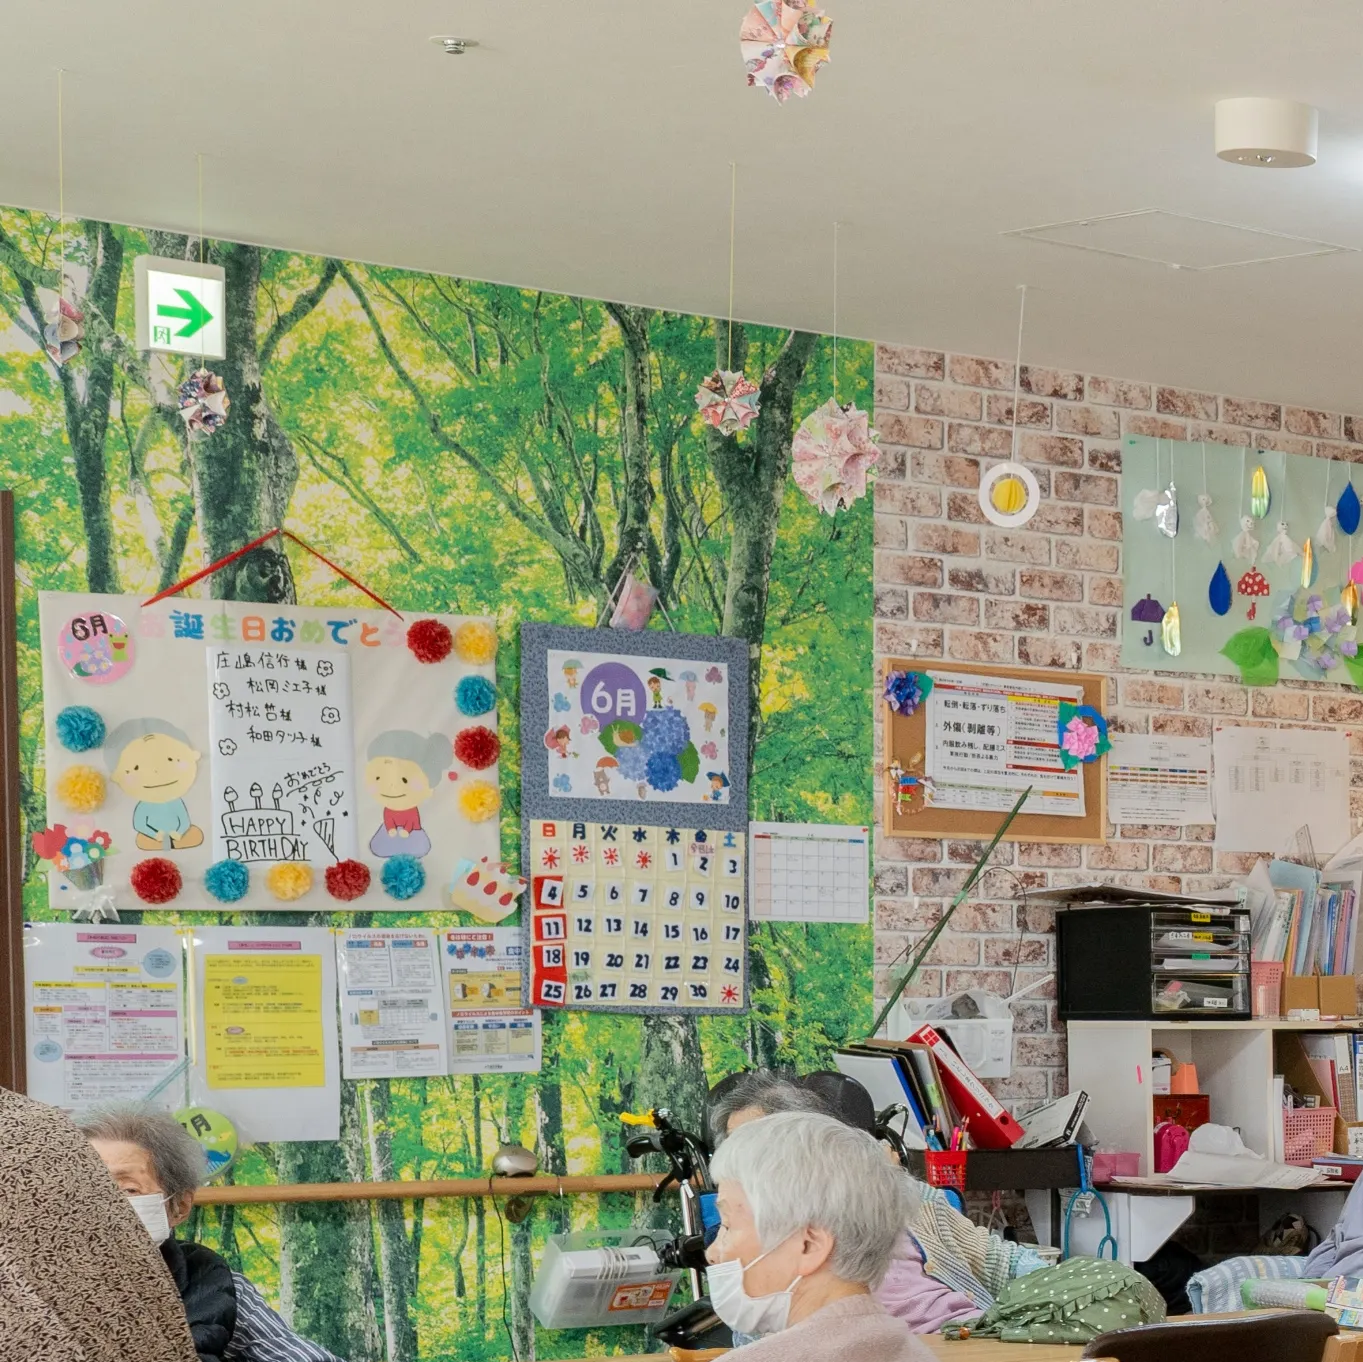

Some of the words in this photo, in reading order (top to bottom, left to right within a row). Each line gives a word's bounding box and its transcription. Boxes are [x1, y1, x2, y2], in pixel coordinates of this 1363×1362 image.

[72, 615, 108, 641] 6月
[591, 682, 636, 716] 6月
[284, 763, 330, 787] おめでとう
[229, 817, 286, 835] HAPPY
[543, 823, 556, 838] 日
[572, 823, 586, 840] 月
[601, 825, 618, 842] 火
[632, 827, 647, 843] 水
[665, 828, 680, 845] 木
[695, 829, 707, 842] 金
[723, 831, 736, 848] 土
[226, 836, 308, 861] BIRTHDAY
[672, 853, 678, 866] 1
[700, 857, 708, 871] 2
[729, 860, 737, 874] 3
[548, 886, 557, 900] 4
[577, 885, 588, 898] 5
[610, 886, 618, 900] 6
[638, 889, 648, 902] 7
[669, 892, 679, 906] 8
[696, 892, 705, 905] 9
[725, 894, 740, 909] 10
[545, 921, 559, 935] 11
[576, 918, 592, 932] 12
[606, 918, 622, 932] 13
[634, 921, 648, 936] 14
[664, 924, 680, 938] 15
[693, 927, 708, 940] 16
[725, 926, 740, 940] 17
[545, 949, 560, 964] 18
[574, 952, 590, 966] 19
[606, 954, 624, 968] 20
[635, 954, 649, 969] 21
[665, 956, 680, 970] 22
[692, 956, 708, 970] 23
[724, 957, 740, 972] 24
[544, 984, 562, 999] 25
[574, 985, 592, 999] 26
[600, 983, 617, 997] 27
[629, 984, 647, 998] 28
[661, 986, 678, 1001] 29
[689, 985, 707, 998] 30
[182, 1114, 211, 1136] 月
